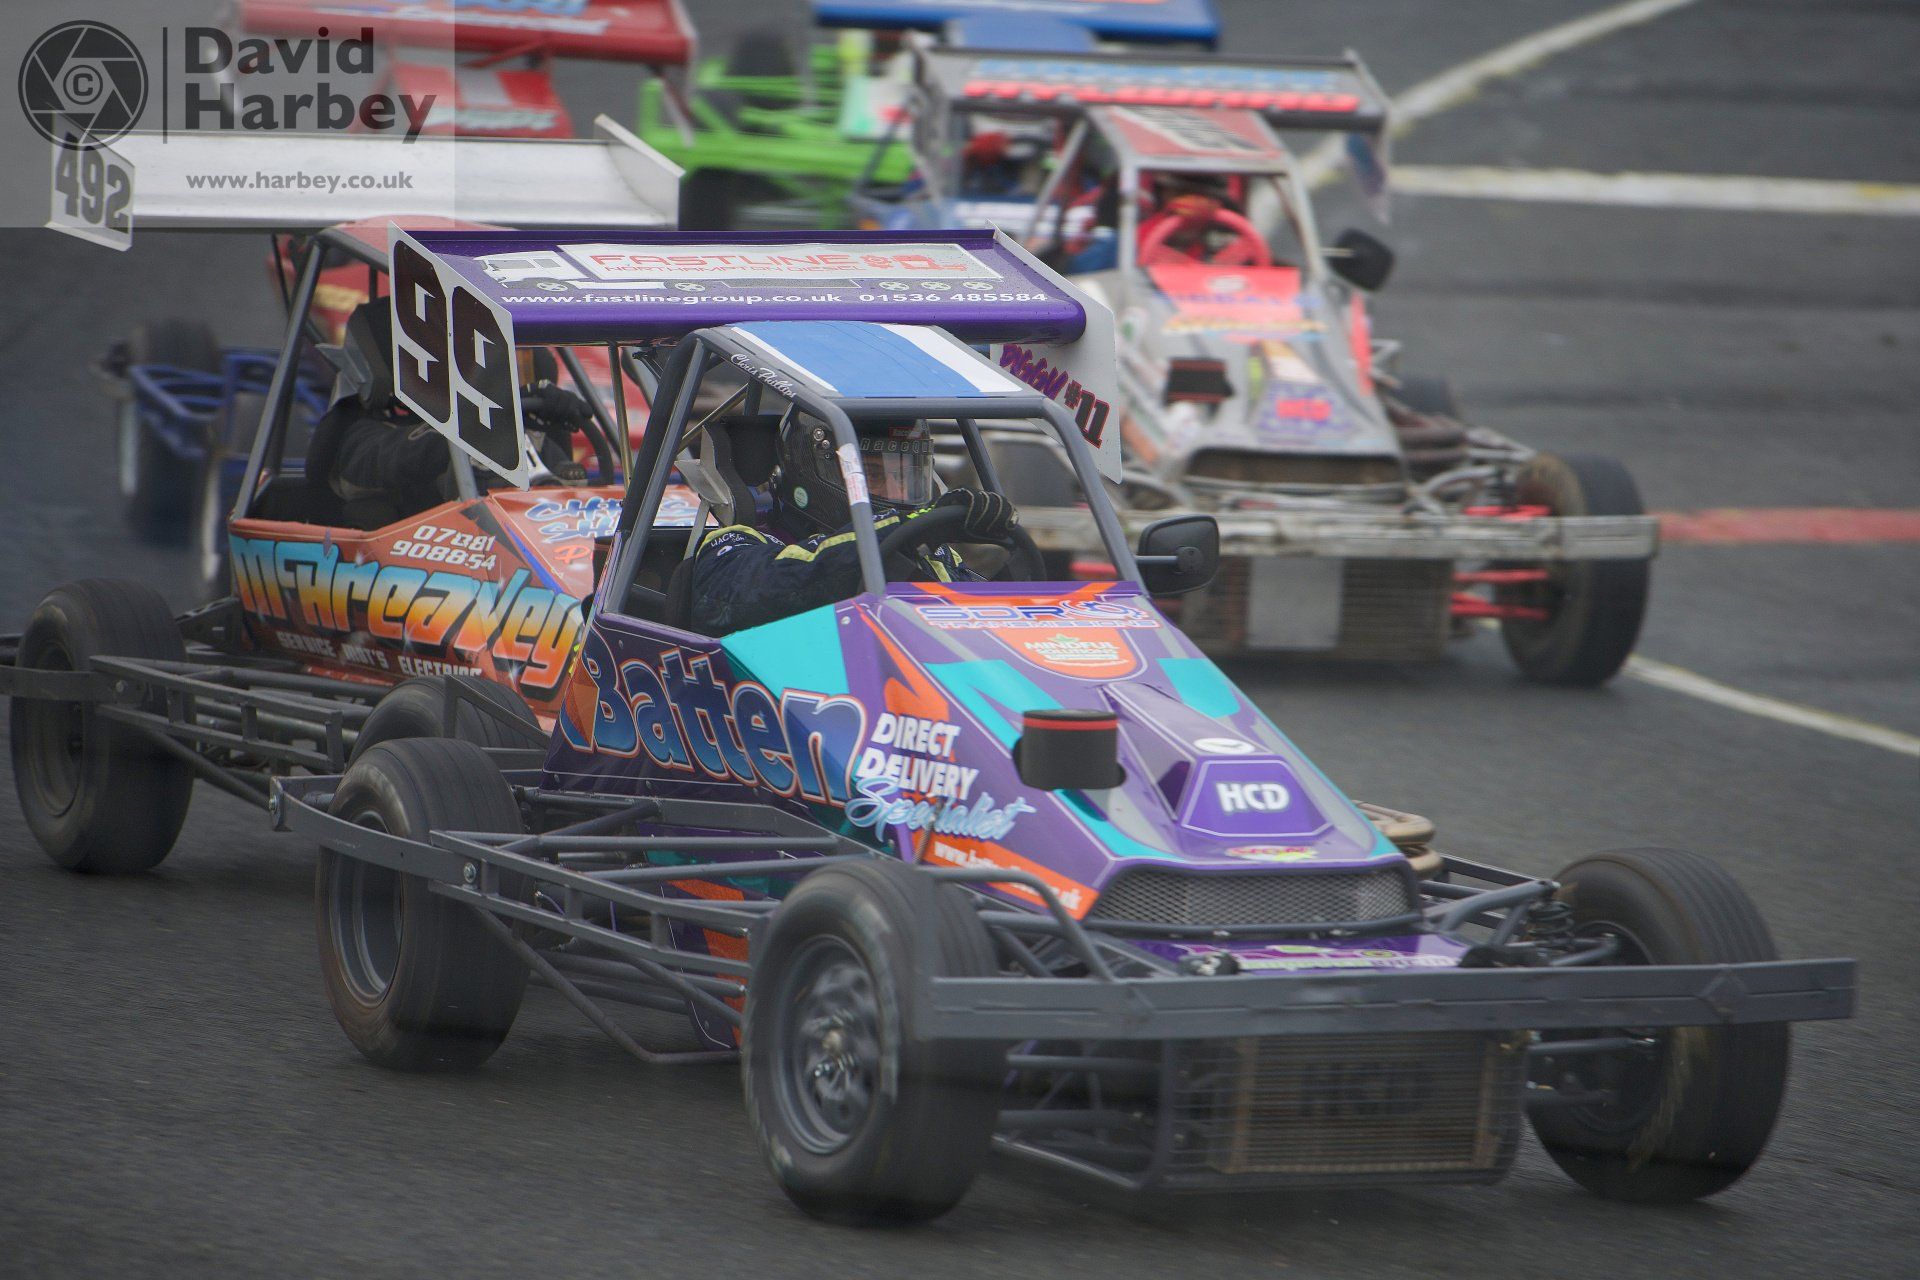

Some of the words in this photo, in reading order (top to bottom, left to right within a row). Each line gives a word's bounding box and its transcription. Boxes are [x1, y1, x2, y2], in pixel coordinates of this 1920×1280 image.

[55, 132, 132, 234] 492
[589, 254, 860, 266] FASTLINE
[501, 293, 842, 304] www.fastlinegroup.co.uk
[859, 293, 941, 302] 01536
[950, 293, 1048, 302] 485584
[394, 239, 520, 471] 99
[276, 631, 337, 657] SERVICE
[560, 626, 868, 807] Batten
[871, 713, 961, 757] DIRECT
[856, 747, 979, 802] DELIVERY
[1217, 783, 1290, 812] HCD
